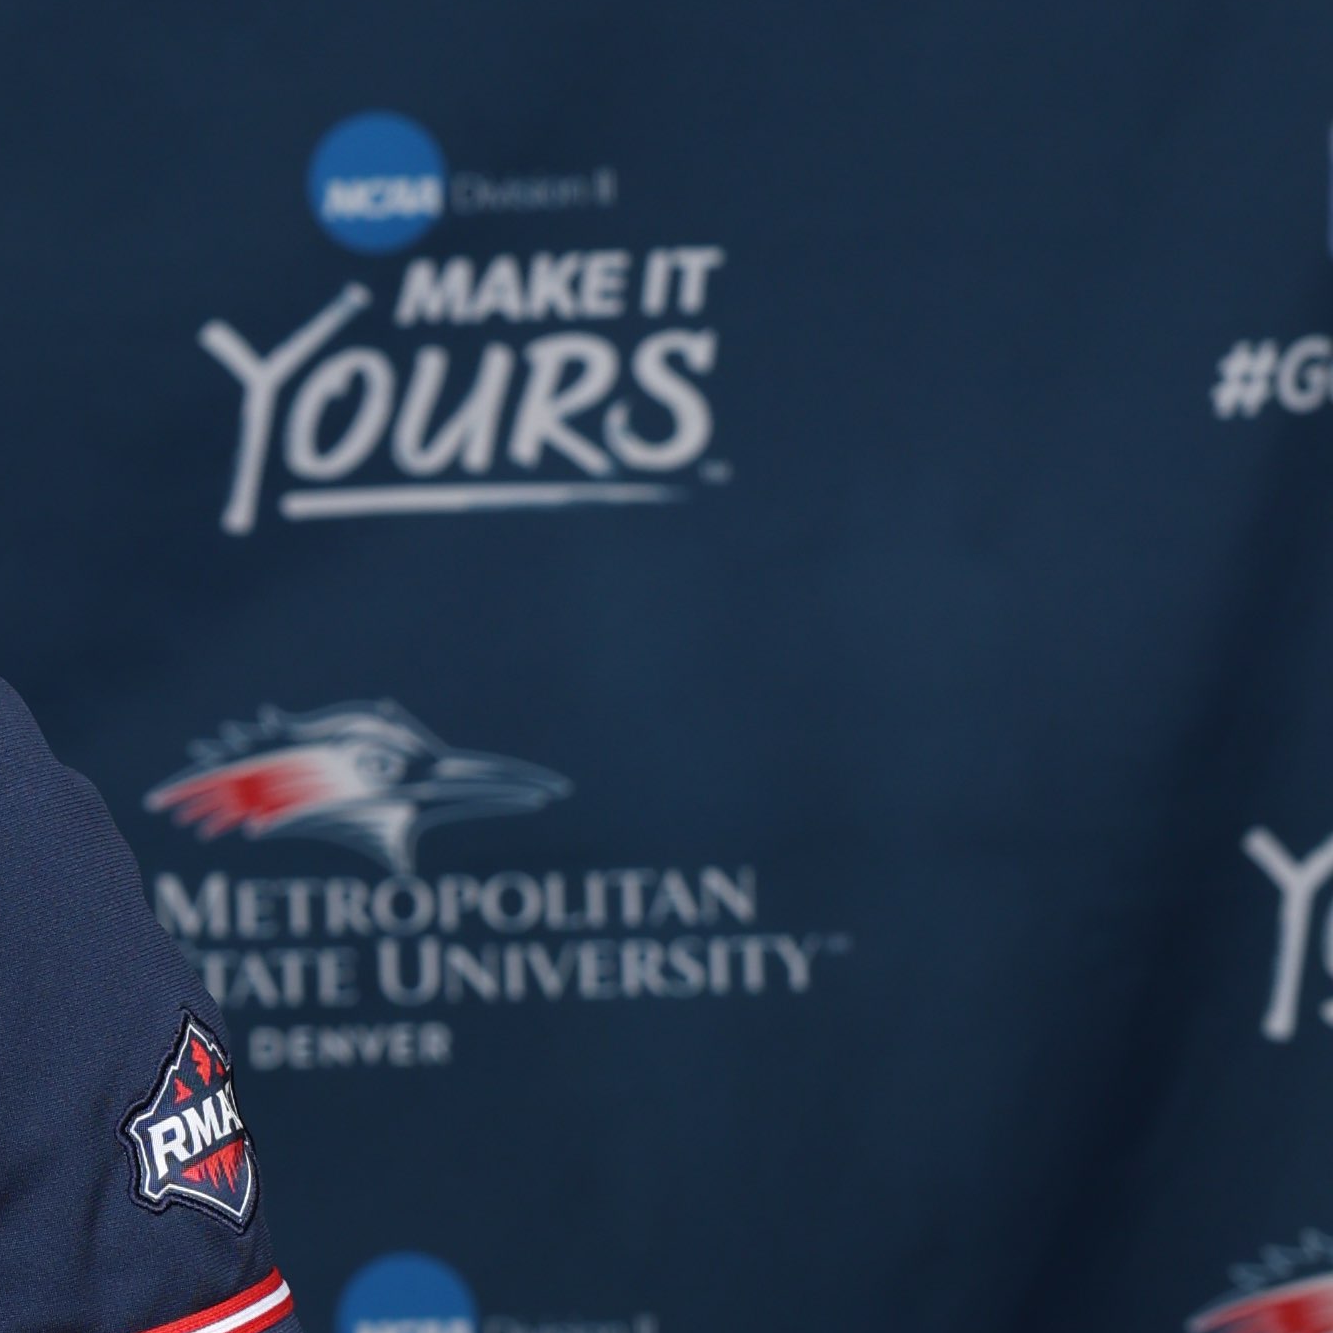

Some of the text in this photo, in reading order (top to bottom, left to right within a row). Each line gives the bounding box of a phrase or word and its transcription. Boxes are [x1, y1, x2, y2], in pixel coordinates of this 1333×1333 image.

[391, 243, 729, 330] MAKE IT
[195, 278, 721, 538] YOURS
[154, 865, 756, 940] METROPOLITAN
[190, 931, 813, 1009] TATE UNIVERSITY
[247, 1021, 454, 1070] DENVER
[148, 1083, 244, 1180] RMA
